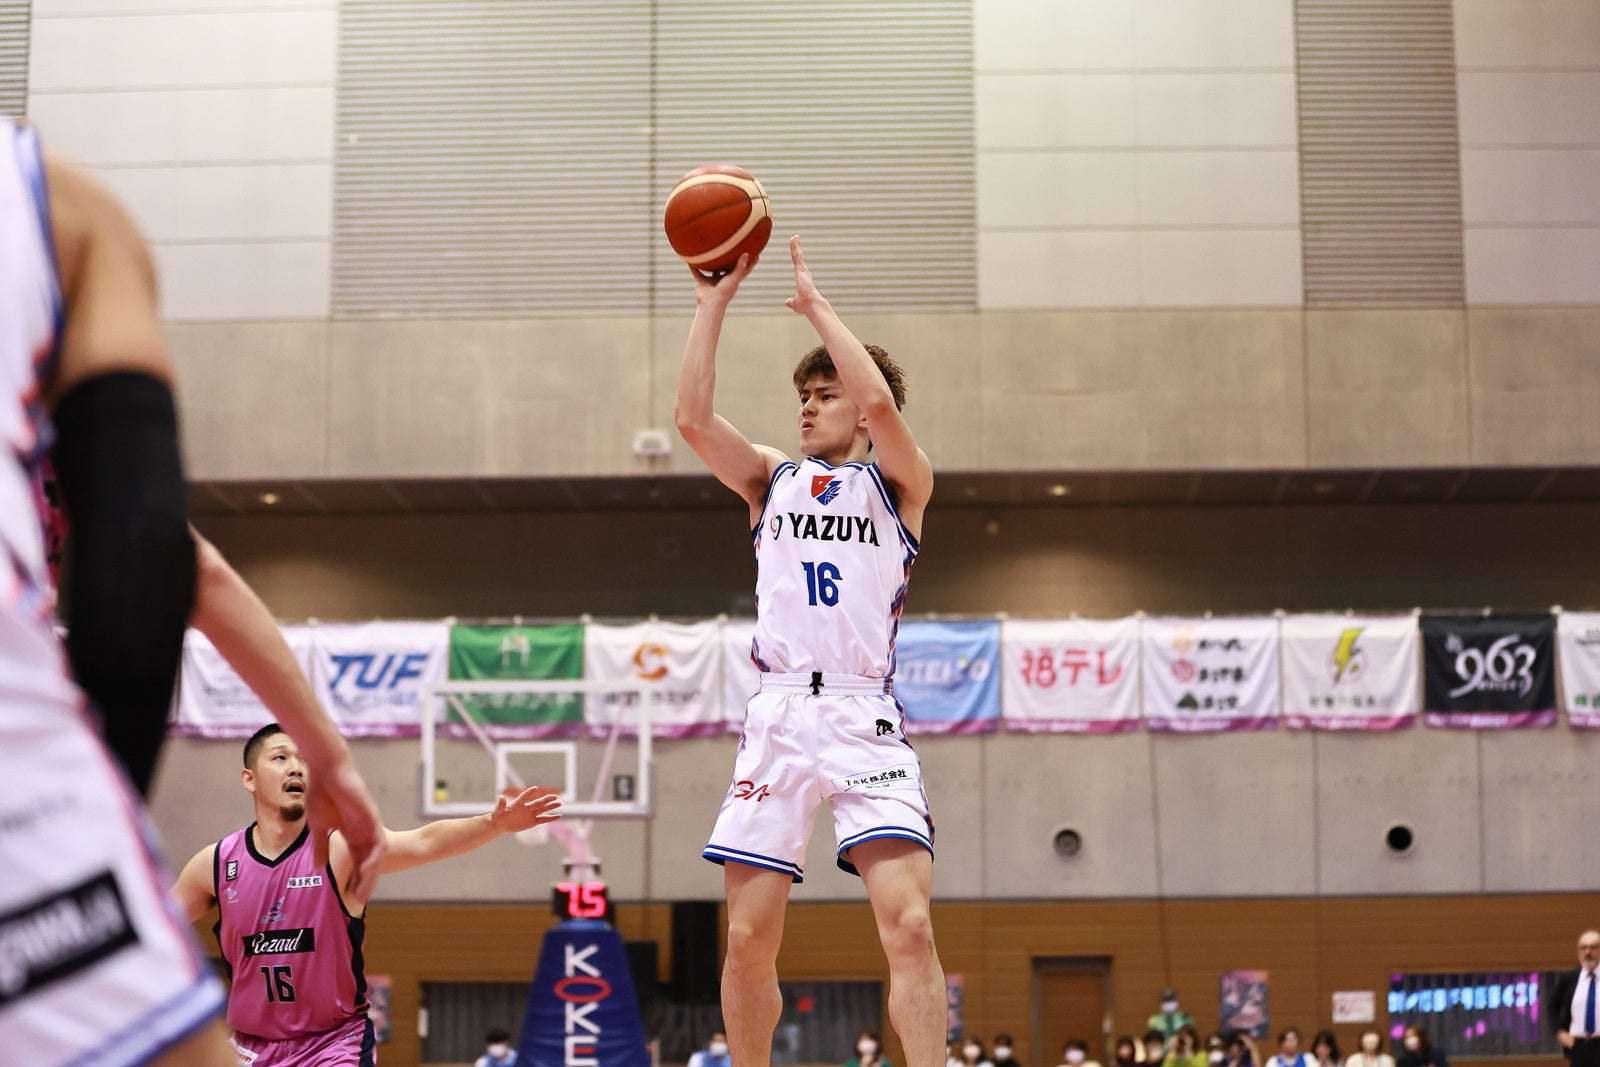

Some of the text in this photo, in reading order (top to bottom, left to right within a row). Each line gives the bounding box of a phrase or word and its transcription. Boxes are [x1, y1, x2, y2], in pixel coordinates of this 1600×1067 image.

[787, 512, 880, 546] YAZUYA
[800, 561, 843, 607] 16
[328, 653, 429, 688] TUF
[1021, 648, 1123, 688] 福テレ
[1448, 633, 1537, 698] 963
[869, 769, 907, 782] 株式会社
[252, 929, 304, 954] Rezard
[260, 966, 296, 1003] 16
